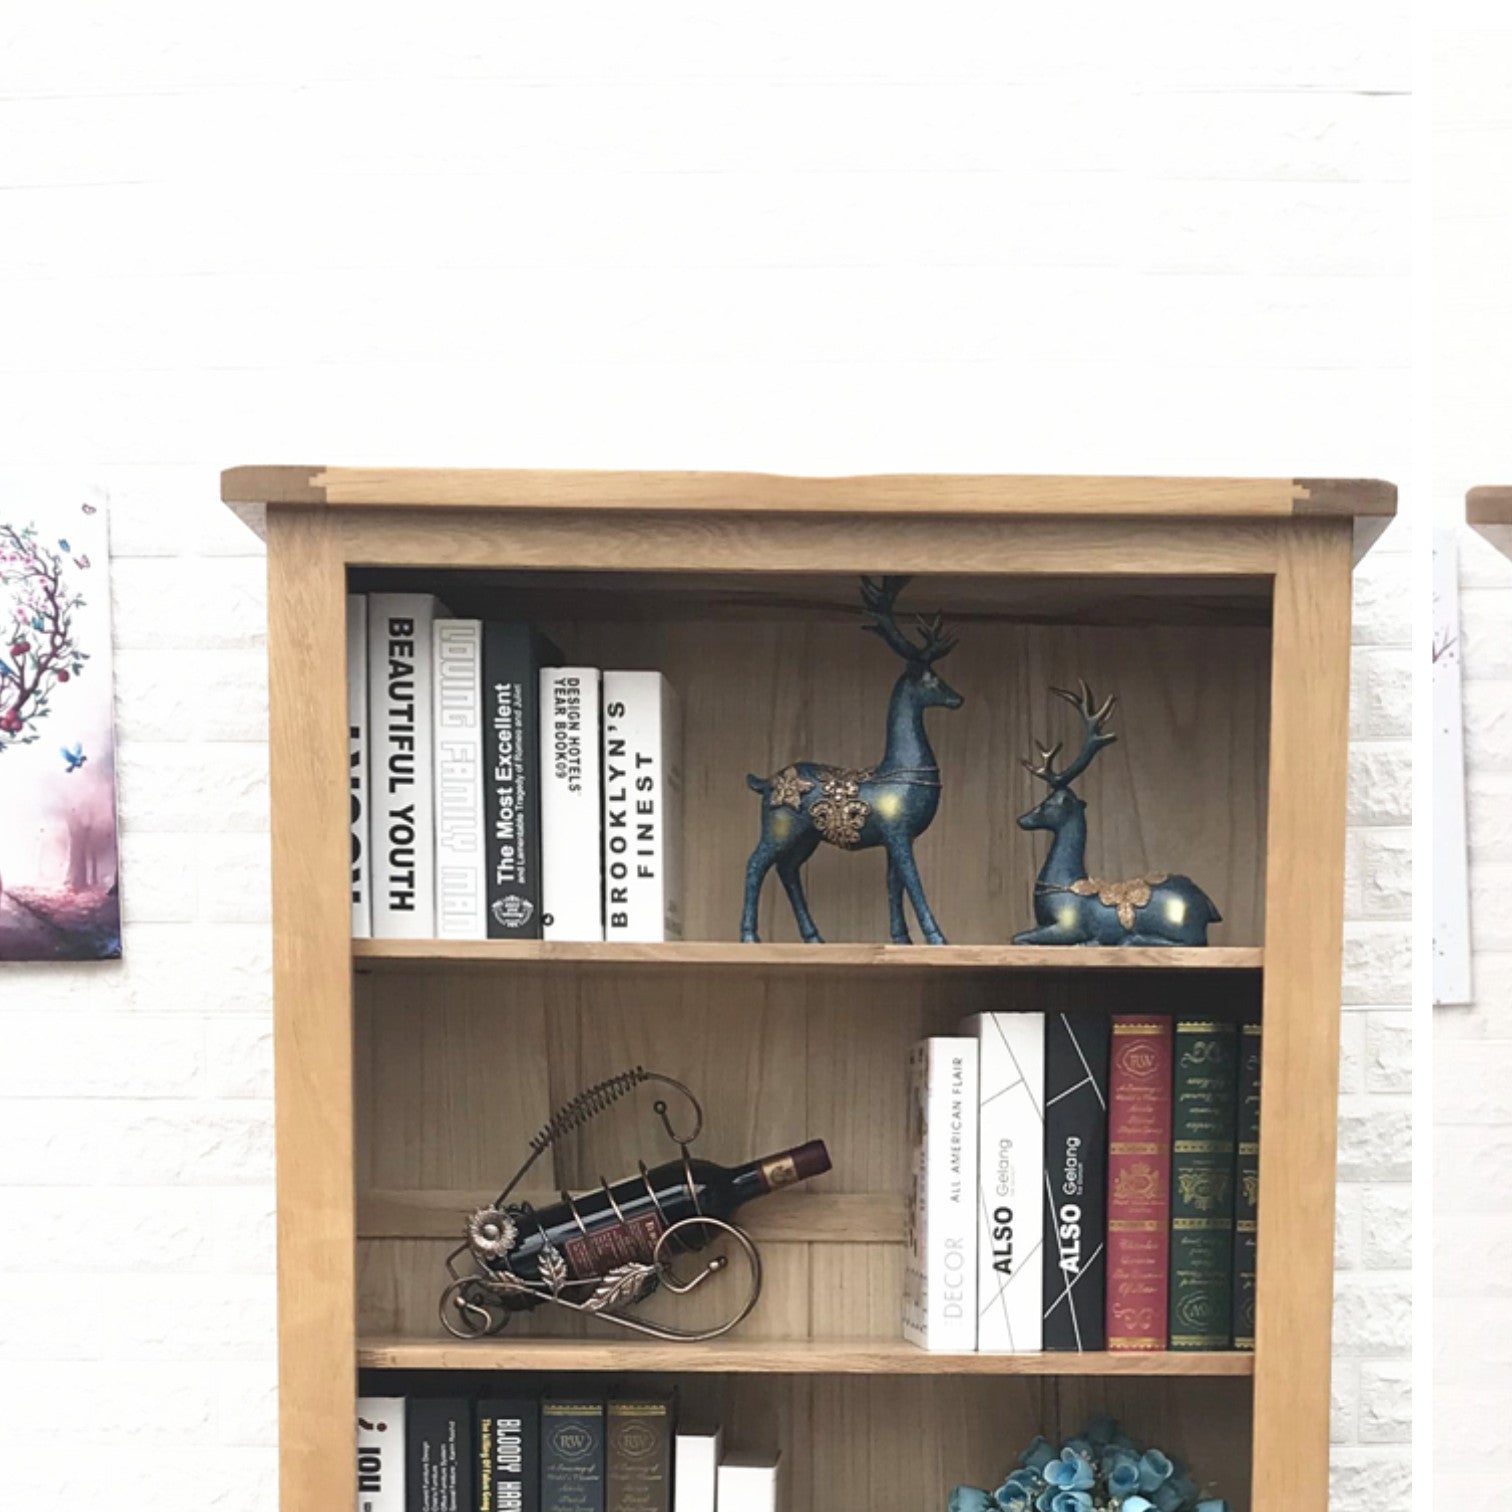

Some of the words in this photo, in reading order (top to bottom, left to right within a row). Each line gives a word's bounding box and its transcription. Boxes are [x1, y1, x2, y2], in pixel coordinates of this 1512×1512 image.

[388, 616, 415, 794] BEAUTIFUL
[440, 627, 477, 728] LOVING
[554, 678, 566, 715] YEAR
[568, 678, 581, 731] DESIGN
[493, 682, 514, 782] Excellent
[441, 741, 477, 851] FAMILY
[514, 774, 526, 811] Tragedy
[568, 740, 582, 793] HOTELS
[495, 788, 514, 839] Most
[608, 701, 627, 928] BROOKLYN'S
[635, 753, 655, 879] FINEST
[388, 804, 415, 911] YOUTH
[497, 845, 516, 885] The
[441, 866, 478, 932] MAN
[952, 1056, 963, 1094] FLAIR
[951, 1101, 962, 1173] AMERICAN
[996, 1138, 1013, 1198] Gelang
[1063, 1136, 1081, 1196] Gelang
[951, 1177, 961, 1203] ALL
[992, 1206, 1014, 1276] ALSO
[1059, 1203, 1081, 1274] ALSO
[944, 1238, 965, 1320] DECOR
[358, 1447, 382, 1493] noi
[497, 1418, 522, 1473] BLOODY
